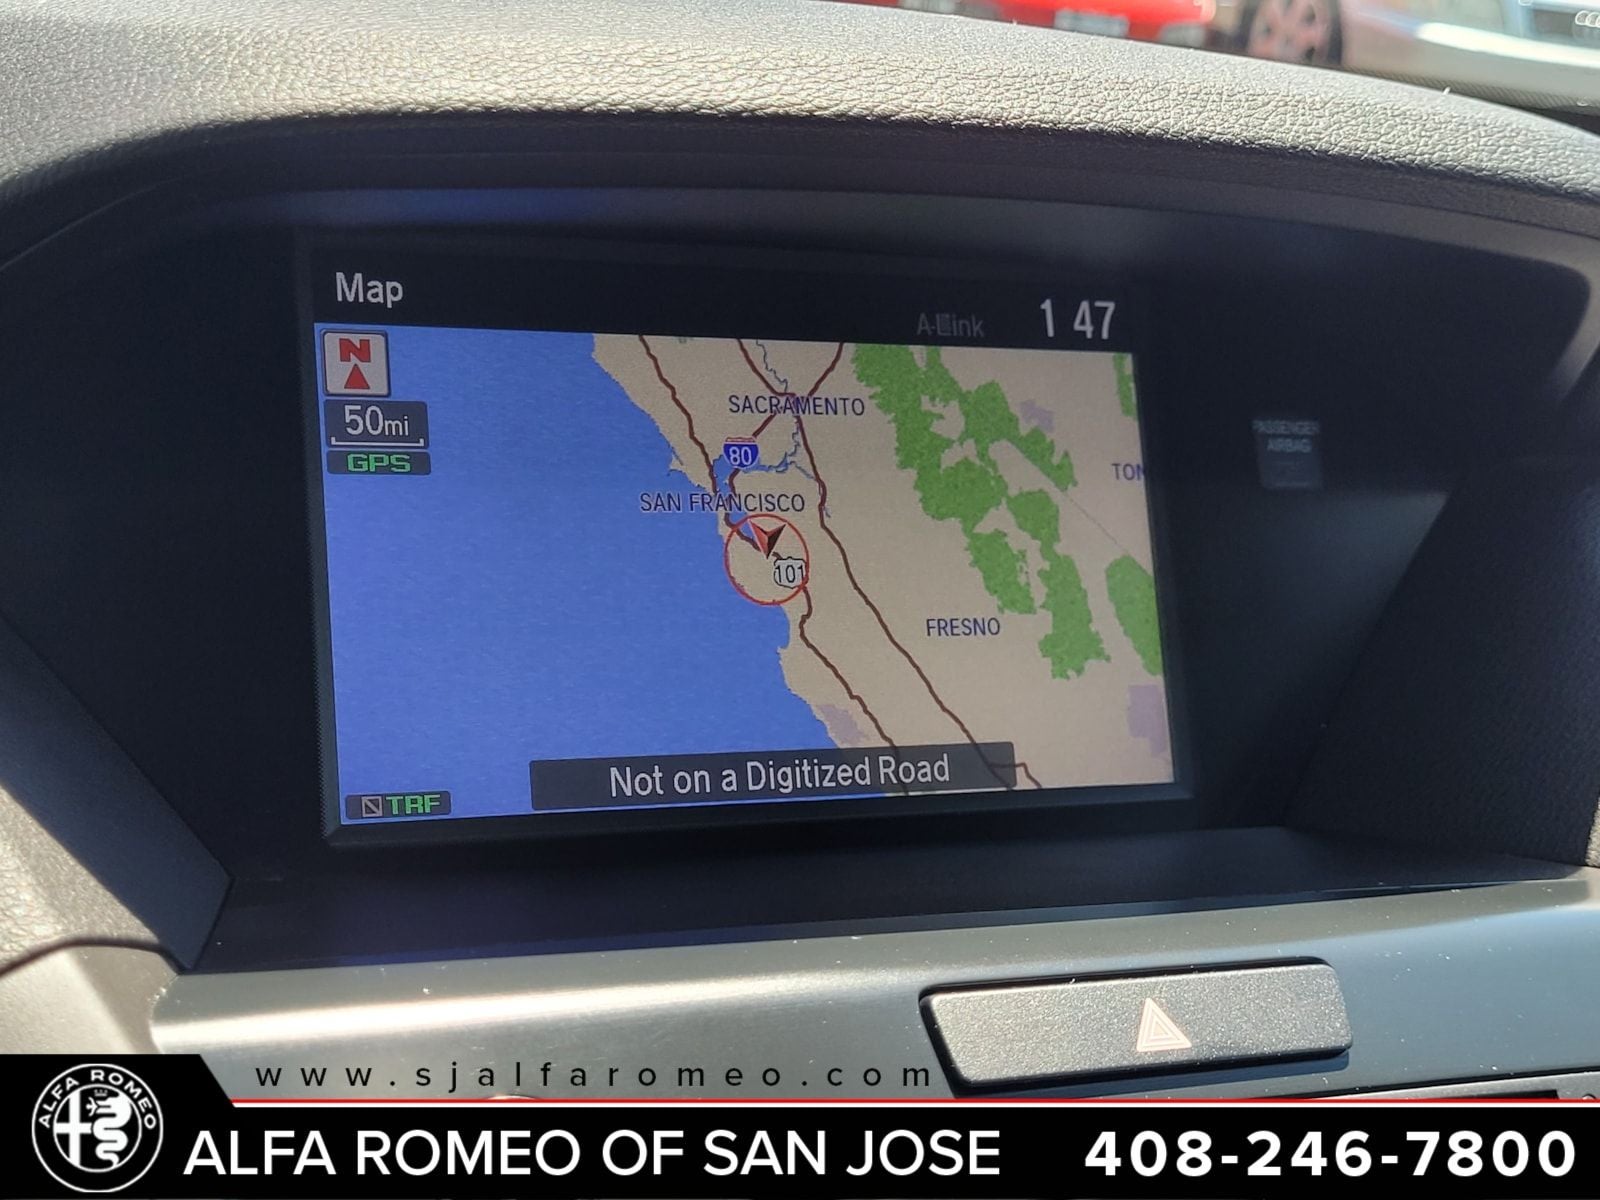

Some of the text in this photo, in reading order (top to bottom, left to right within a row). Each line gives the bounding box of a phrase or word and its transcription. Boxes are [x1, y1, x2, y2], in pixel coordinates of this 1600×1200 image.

[335, 271, 404, 308] Map
[1073, 301, 1116, 340] 47
[338, 337, 372, 363] N
[728, 395, 865, 417] SACRAMENTO
[344, 405, 409, 437] 50mi
[347, 453, 412, 473] GPS
[728, 446, 751, 466] 80
[640, 493, 806, 513] SAN FRANCISCO
[775, 564, 806, 584] 101
[926, 617, 1001, 637] FRESNO
[609, 753, 950, 797] Not on a Digitized Road
[385, 794, 441, 815] TRF
